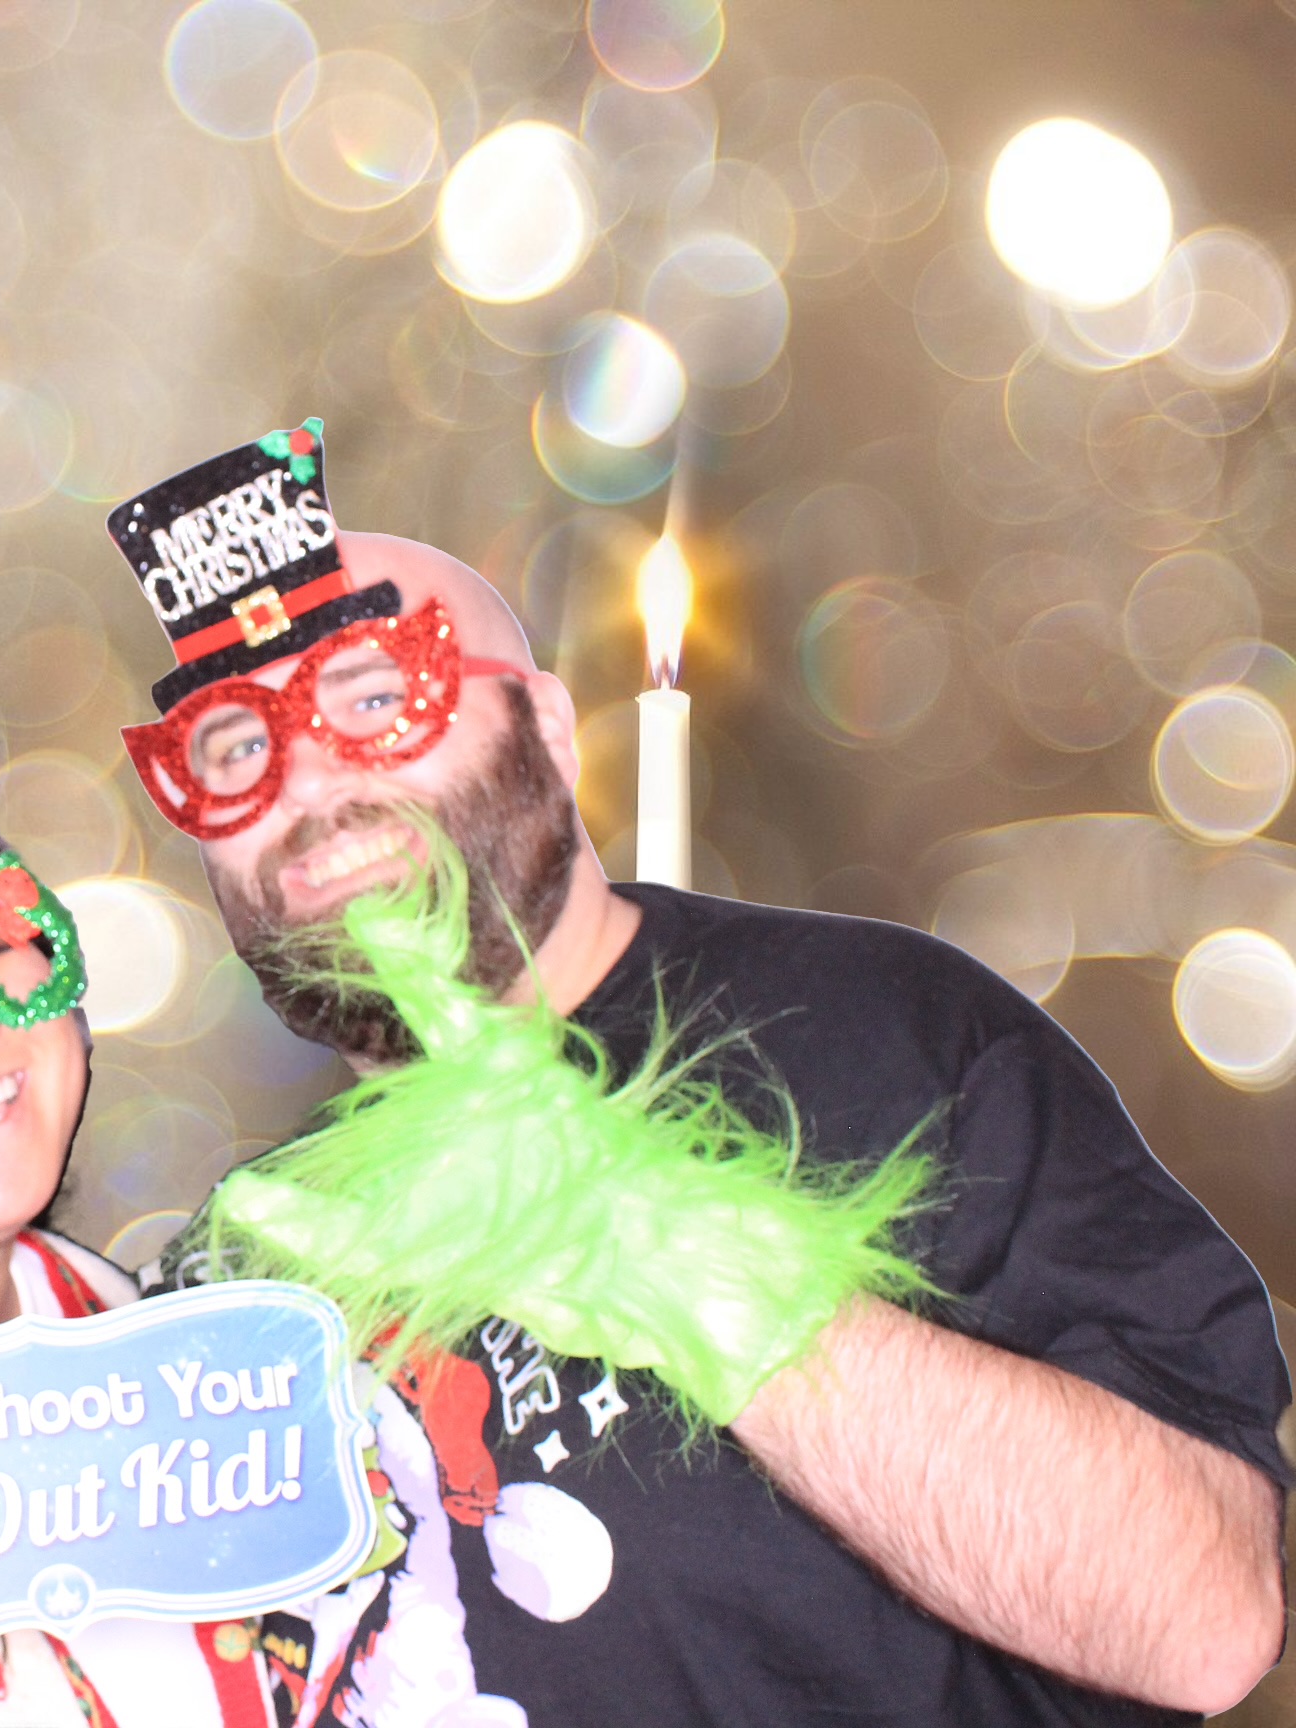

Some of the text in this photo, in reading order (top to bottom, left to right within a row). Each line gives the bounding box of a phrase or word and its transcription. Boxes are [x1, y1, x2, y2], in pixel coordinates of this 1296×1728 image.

[144, 490, 335, 622] CHRISTMAS
[150, 467, 286, 572] MERRY
[159, 1361, 296, 1418] Your
[120, 1425, 302, 1528] Kid!
